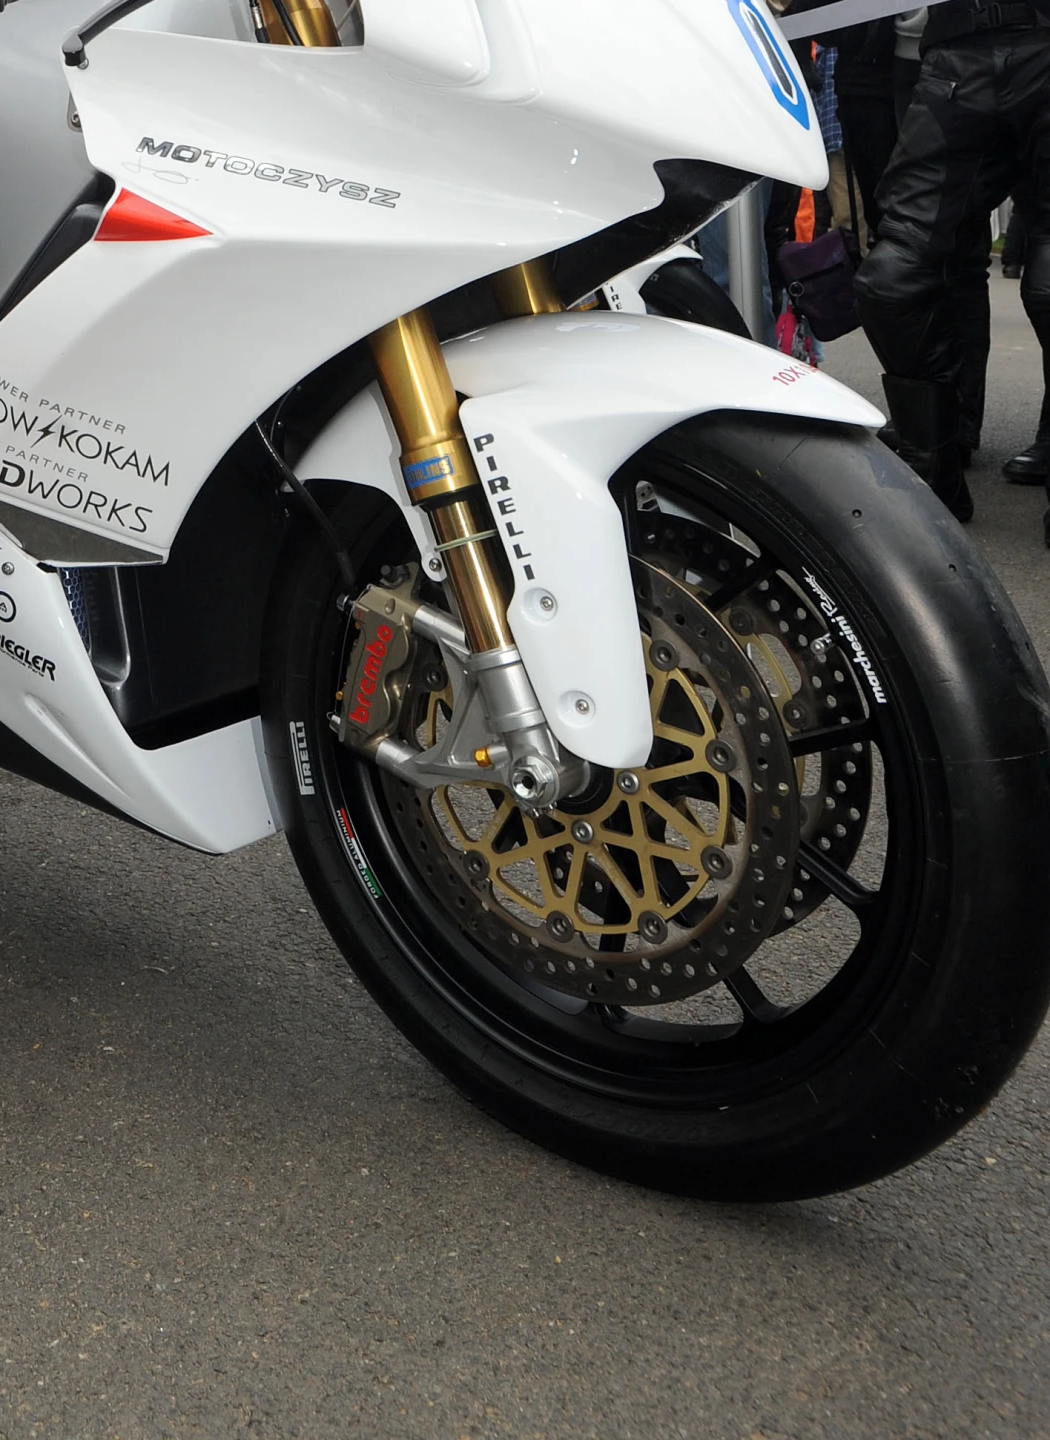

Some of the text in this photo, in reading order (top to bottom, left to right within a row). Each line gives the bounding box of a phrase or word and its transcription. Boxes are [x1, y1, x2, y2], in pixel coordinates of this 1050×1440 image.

[136, 136, 401, 209] MOTOCZYSZ
[39, 398, 126, 435] PARTNER
[5, 445, 89, 483] PARTNER
[58, 425, 170, 486] KOKAM
[473, 433, 535, 581] PIRELLI
[802, 566, 887, 704] marchesini Racing
[350, 624, 394, 725] brembo
[289, 721, 315, 795] PIRELLI
[357, 863, 379, 899] FORGED
